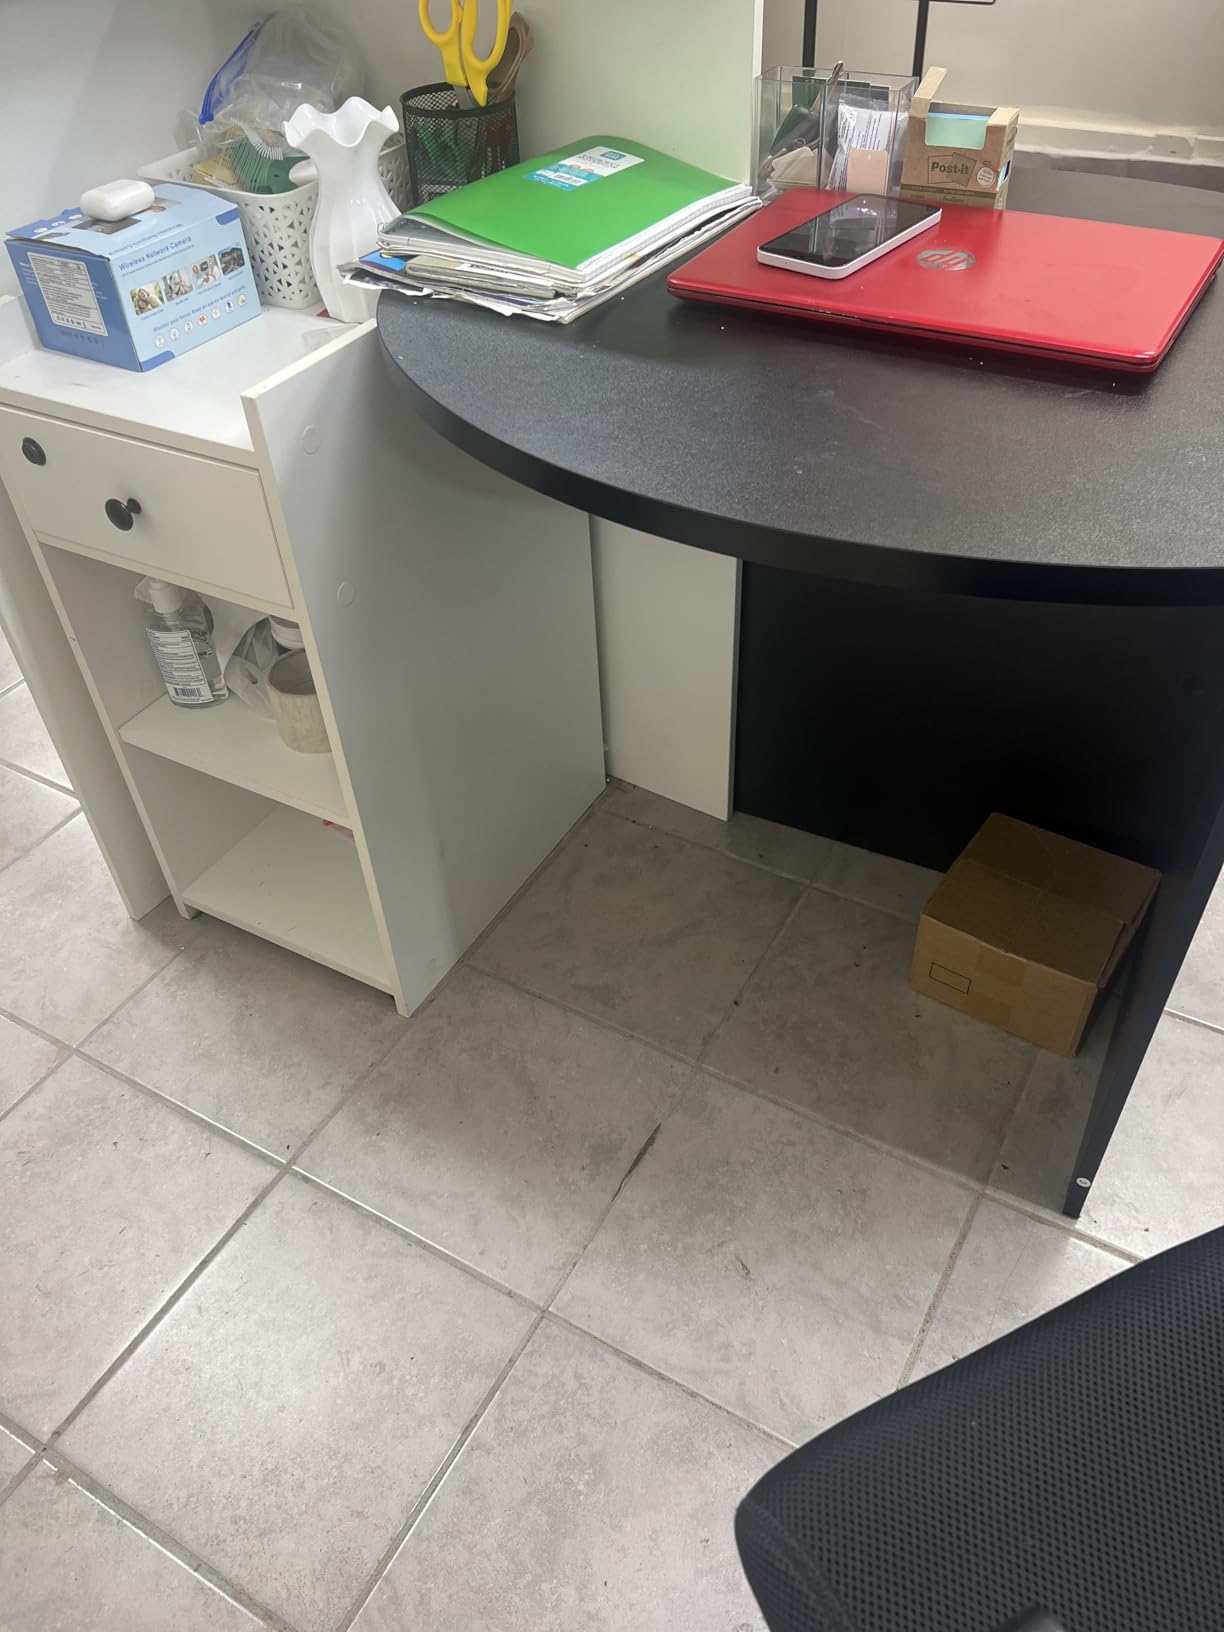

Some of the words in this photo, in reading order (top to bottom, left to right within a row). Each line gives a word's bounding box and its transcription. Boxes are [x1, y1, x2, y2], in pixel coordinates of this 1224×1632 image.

[118, 256, 146, 271] Wireless
[145, 246, 170, 260] Network
[169, 236, 192, 249] Camera
